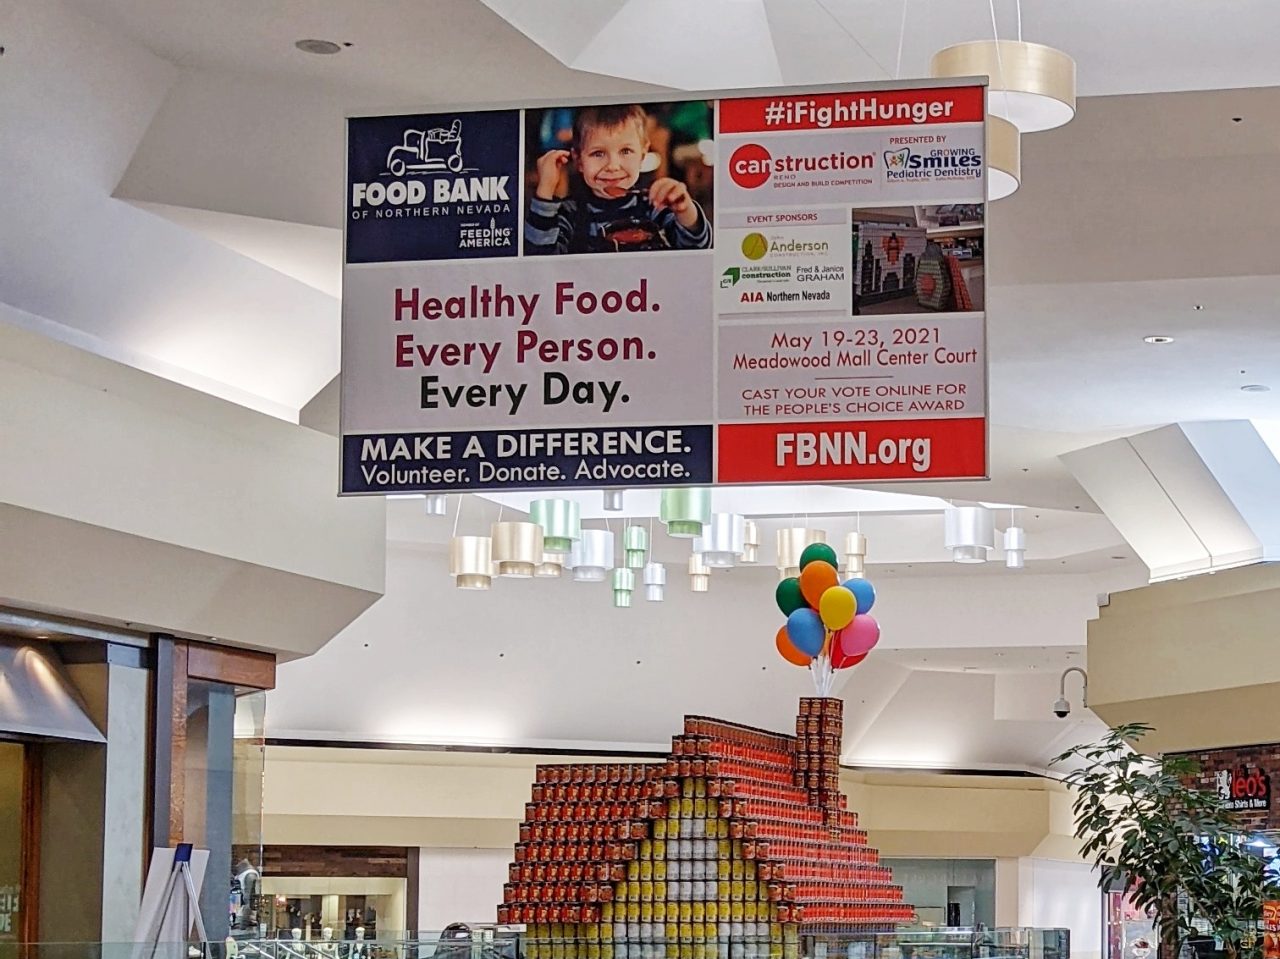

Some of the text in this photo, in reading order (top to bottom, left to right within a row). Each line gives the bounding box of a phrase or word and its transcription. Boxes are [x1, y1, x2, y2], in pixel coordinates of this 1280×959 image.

[765, 97, 954, 127] #iFightHunger
[889, 135, 946, 144] PRESENTED BY
[930, 148, 975, 157] GROWING
[909, 154, 981, 169] Smiles
[886, 168, 981, 179] Pediatric Dentistry
[352, 176, 510, 207] FOOD BANK
[773, 181, 796, 189] DESIGN
[352, 204, 511, 220] OF NORTHERN NEVADA
[747, 213, 818, 223] EVENT SPONSORS
[460, 227, 511, 239] FEEDING
[459, 237, 511, 248] AMERICA
[770, 239, 829, 252] Anderson
[796, 264, 844, 273] Fred & Janice
[796, 273, 845, 282] GRAHAM
[394, 279, 661, 326] Healthy Food.
[740, 290, 830, 302] AIA Northern Nevada
[771, 328, 940, 351] May 19-23, 2021
[395, 330, 657, 374] Every Person.
[733, 348, 978, 370] Meadowood Mall Center Court
[420, 371, 631, 416] Every Day.
[742, 383, 967, 400] CAST YOUR VOTE ONLINE FOR
[744, 399, 965, 415] THE PEOPLE'S CHOICE AWARD
[360, 430, 692, 461] MAKE A DIFFERENCE.
[776, 431, 931, 472] FBNN.org
[360, 458, 691, 486] Volunteer. Donate. Advocate.
